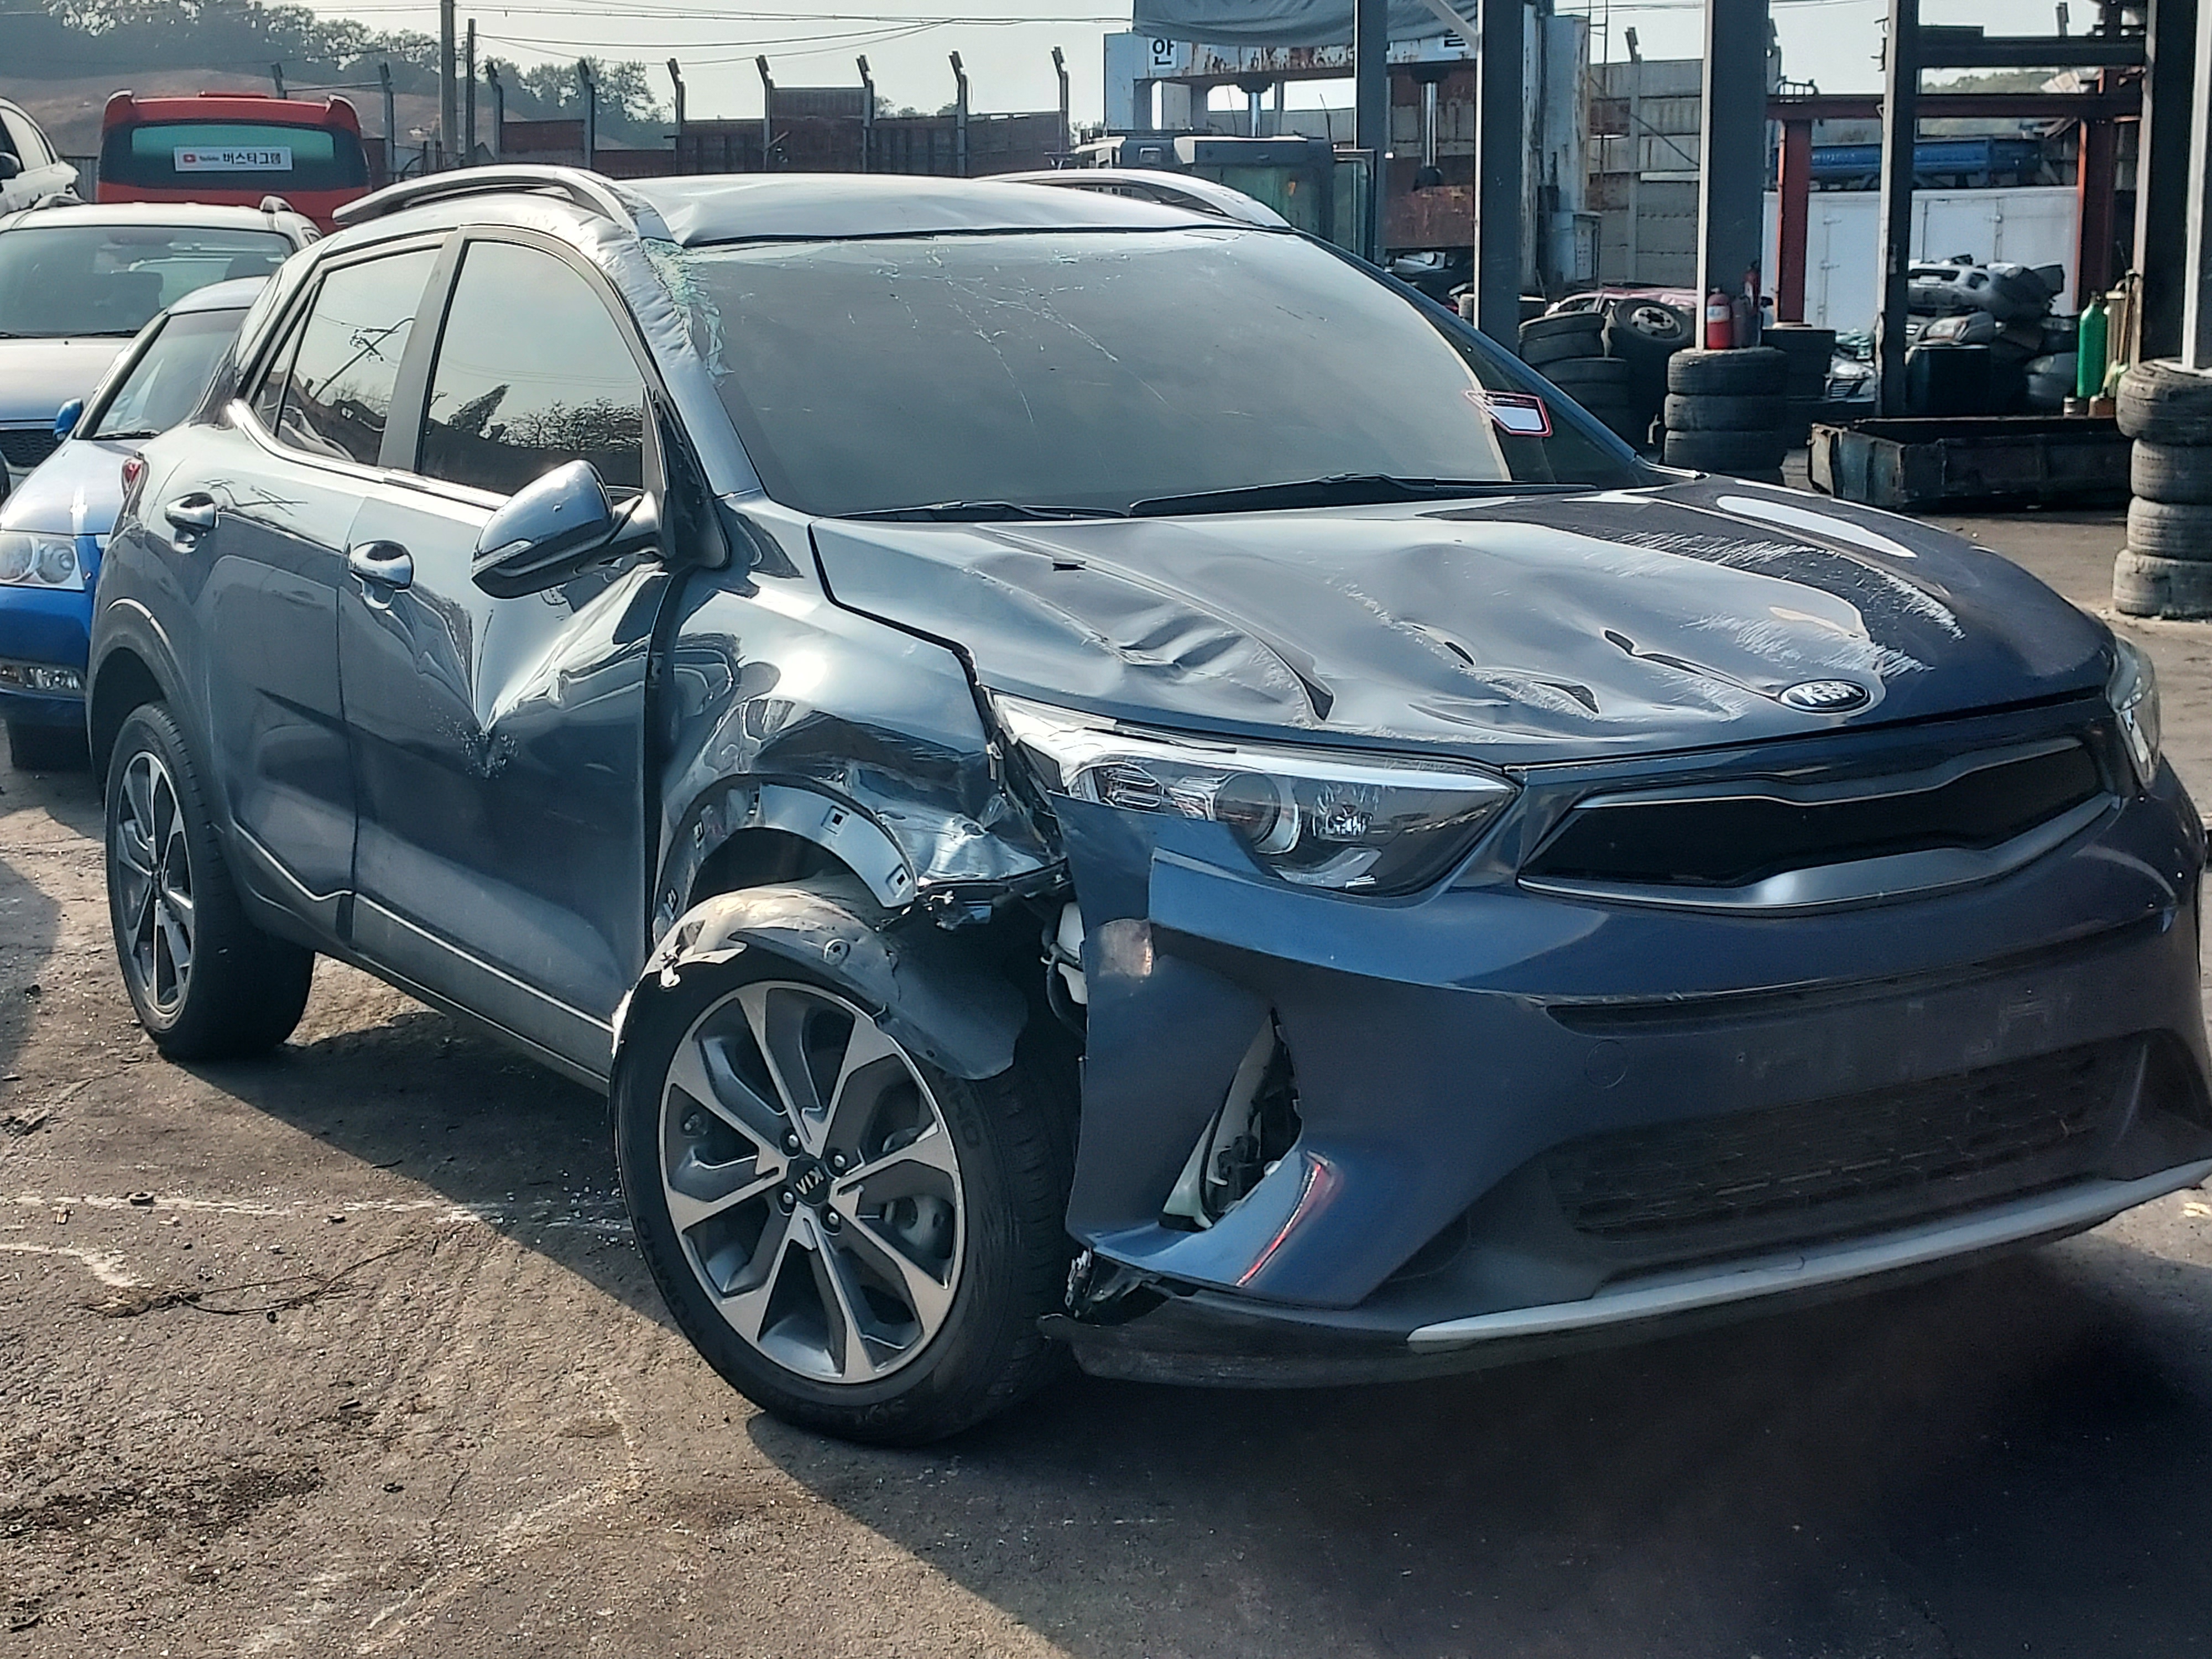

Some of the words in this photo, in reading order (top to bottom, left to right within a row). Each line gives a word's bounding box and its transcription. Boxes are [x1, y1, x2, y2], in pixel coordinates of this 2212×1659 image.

[1152, 39, 1175, 66] 안
[1791, 682, 1863, 705] KIA
[795, 1166, 825, 1196] KIA
